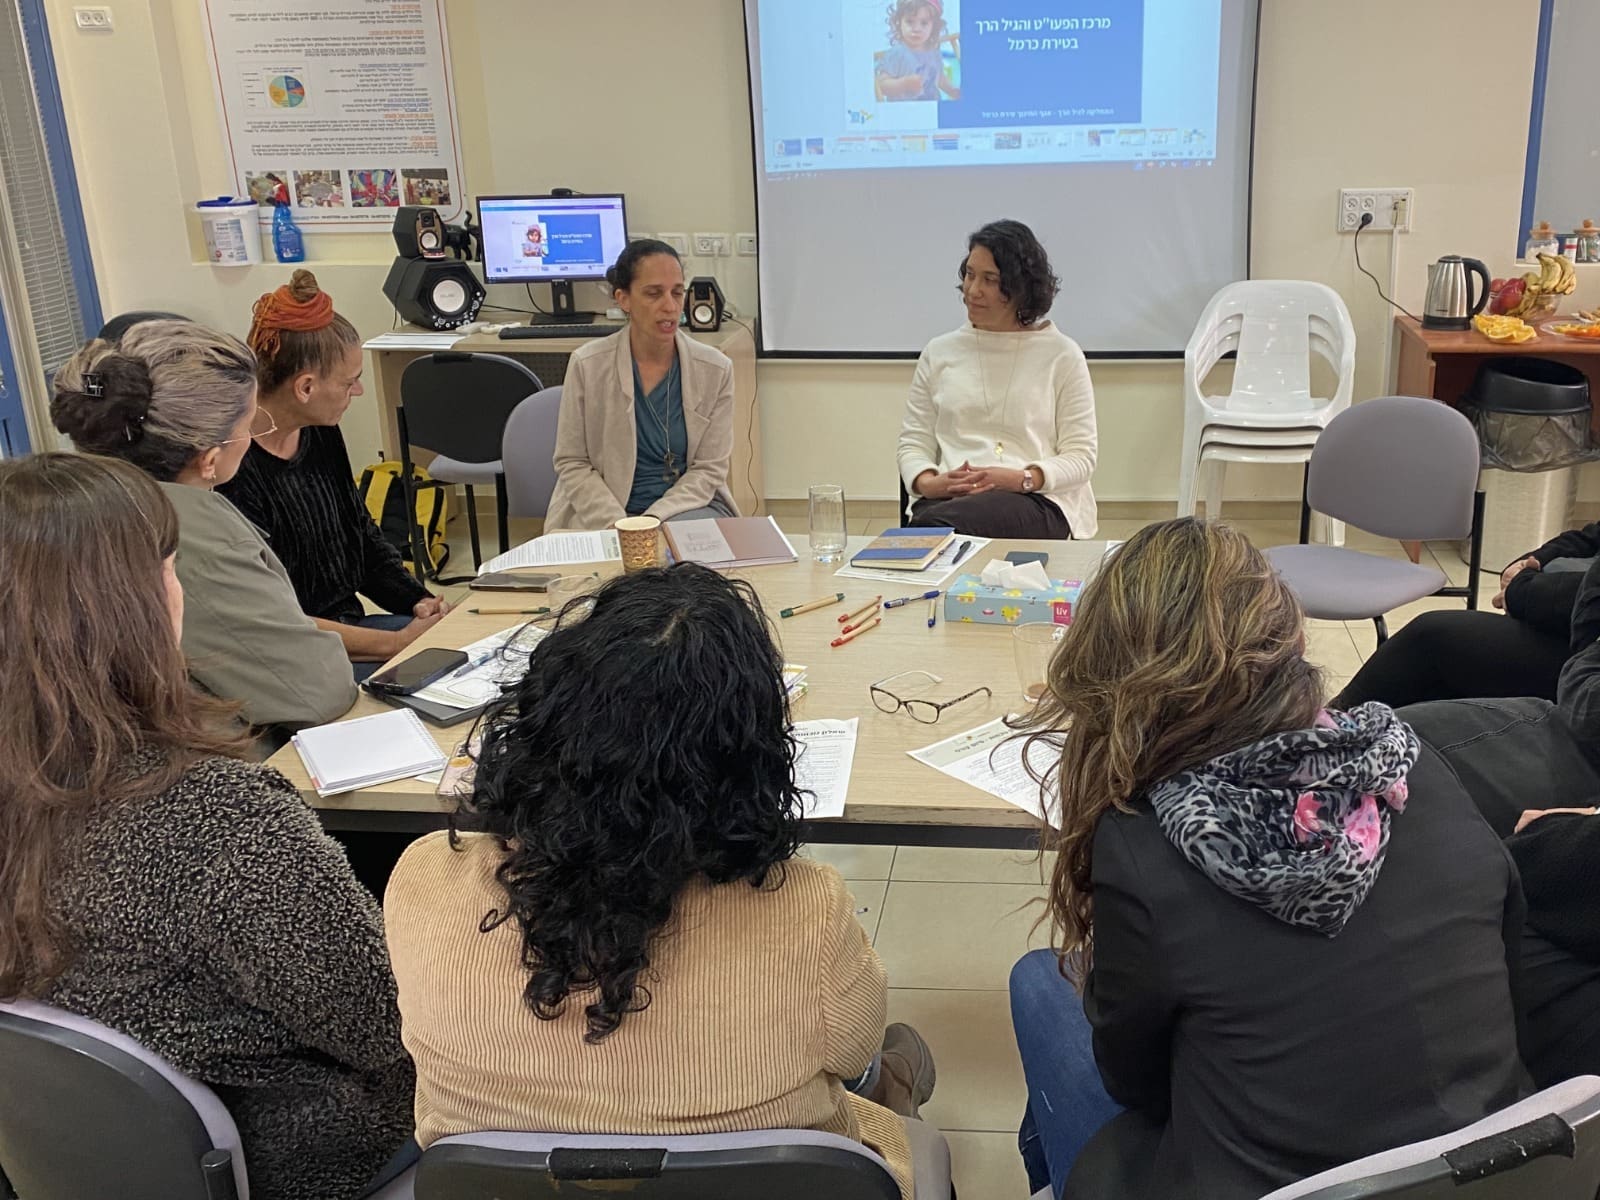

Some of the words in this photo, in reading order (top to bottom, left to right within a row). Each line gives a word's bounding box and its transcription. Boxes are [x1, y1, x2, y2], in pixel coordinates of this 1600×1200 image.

[975, 19, 999, 35] הרך
[1001, 17, 1031, 32] והגיל
[1082, 17, 1111, 30] מרכז
[1007, 37, 1039, 51] כרמל
[1041, 37, 1079, 50] בטירת
